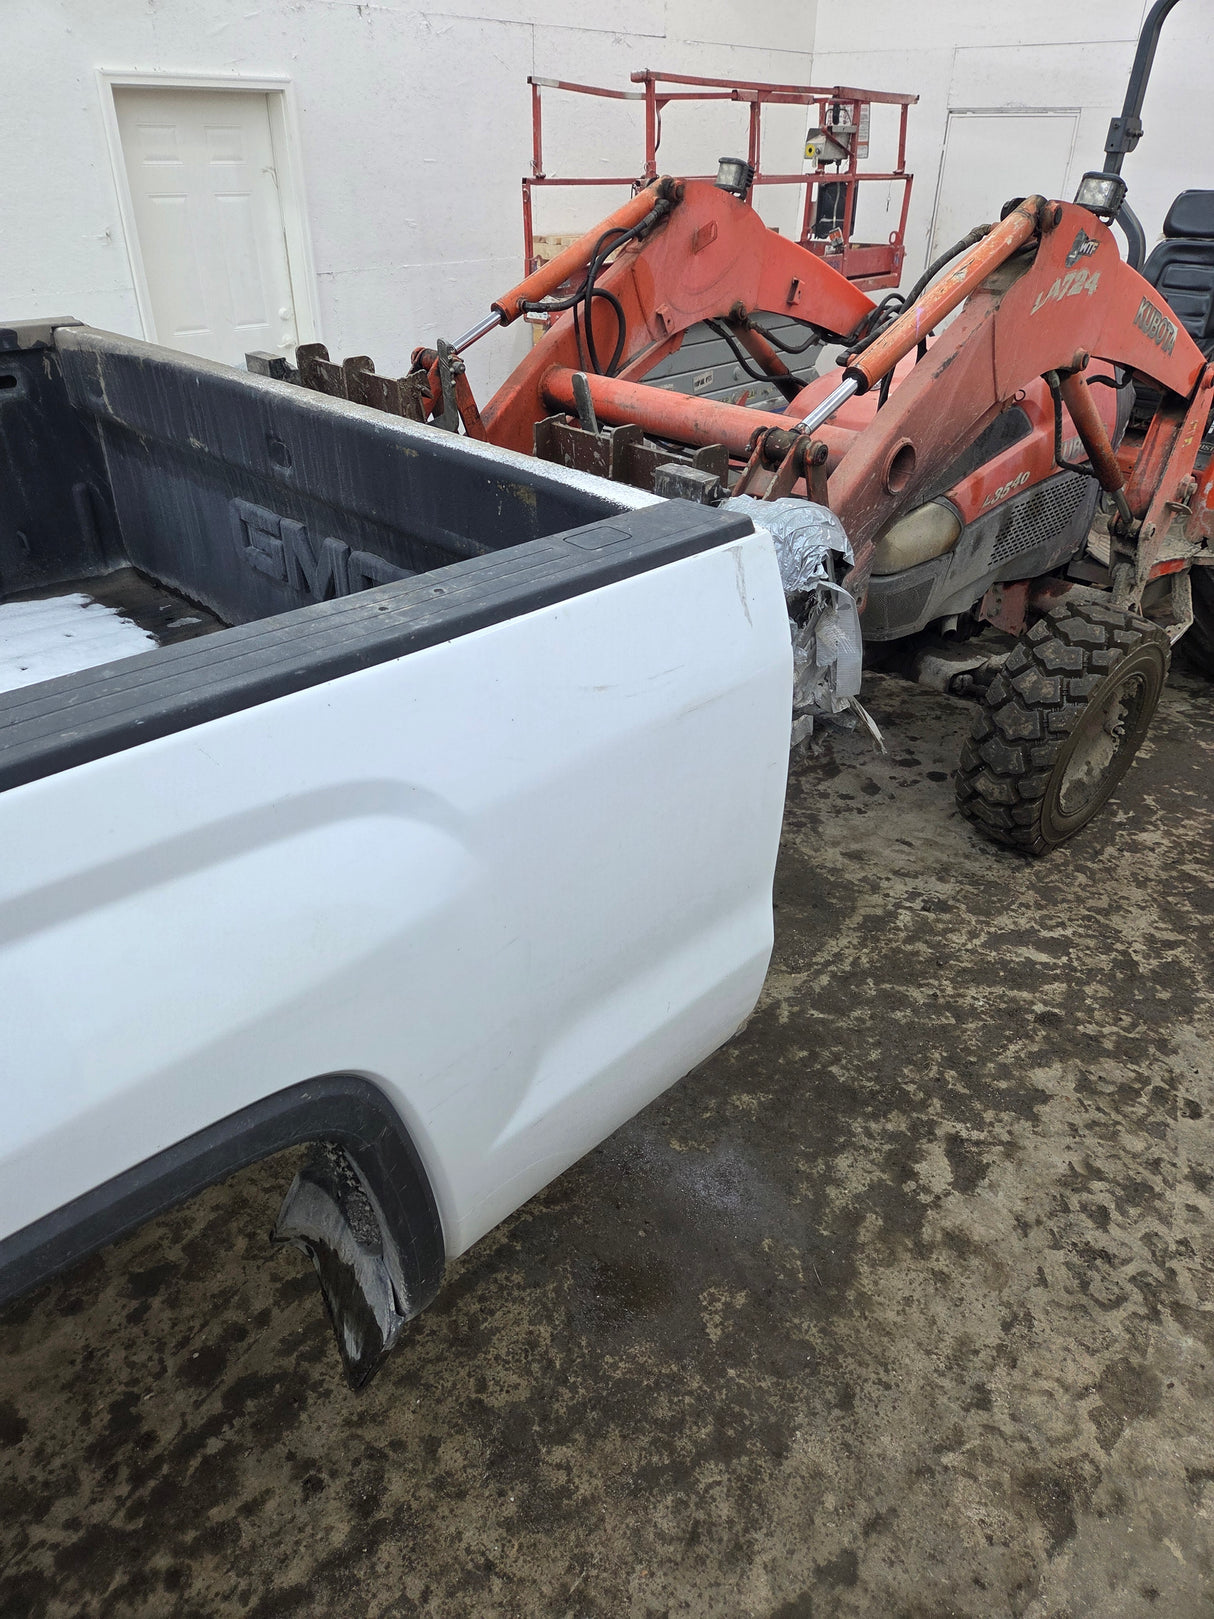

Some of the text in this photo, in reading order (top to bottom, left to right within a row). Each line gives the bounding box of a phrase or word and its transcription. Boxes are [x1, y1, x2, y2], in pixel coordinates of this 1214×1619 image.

[1030, 267, 1101, 317] LA724
[1132, 295, 1179, 358] KUBOTA
[982, 471, 1031, 509] L3540
